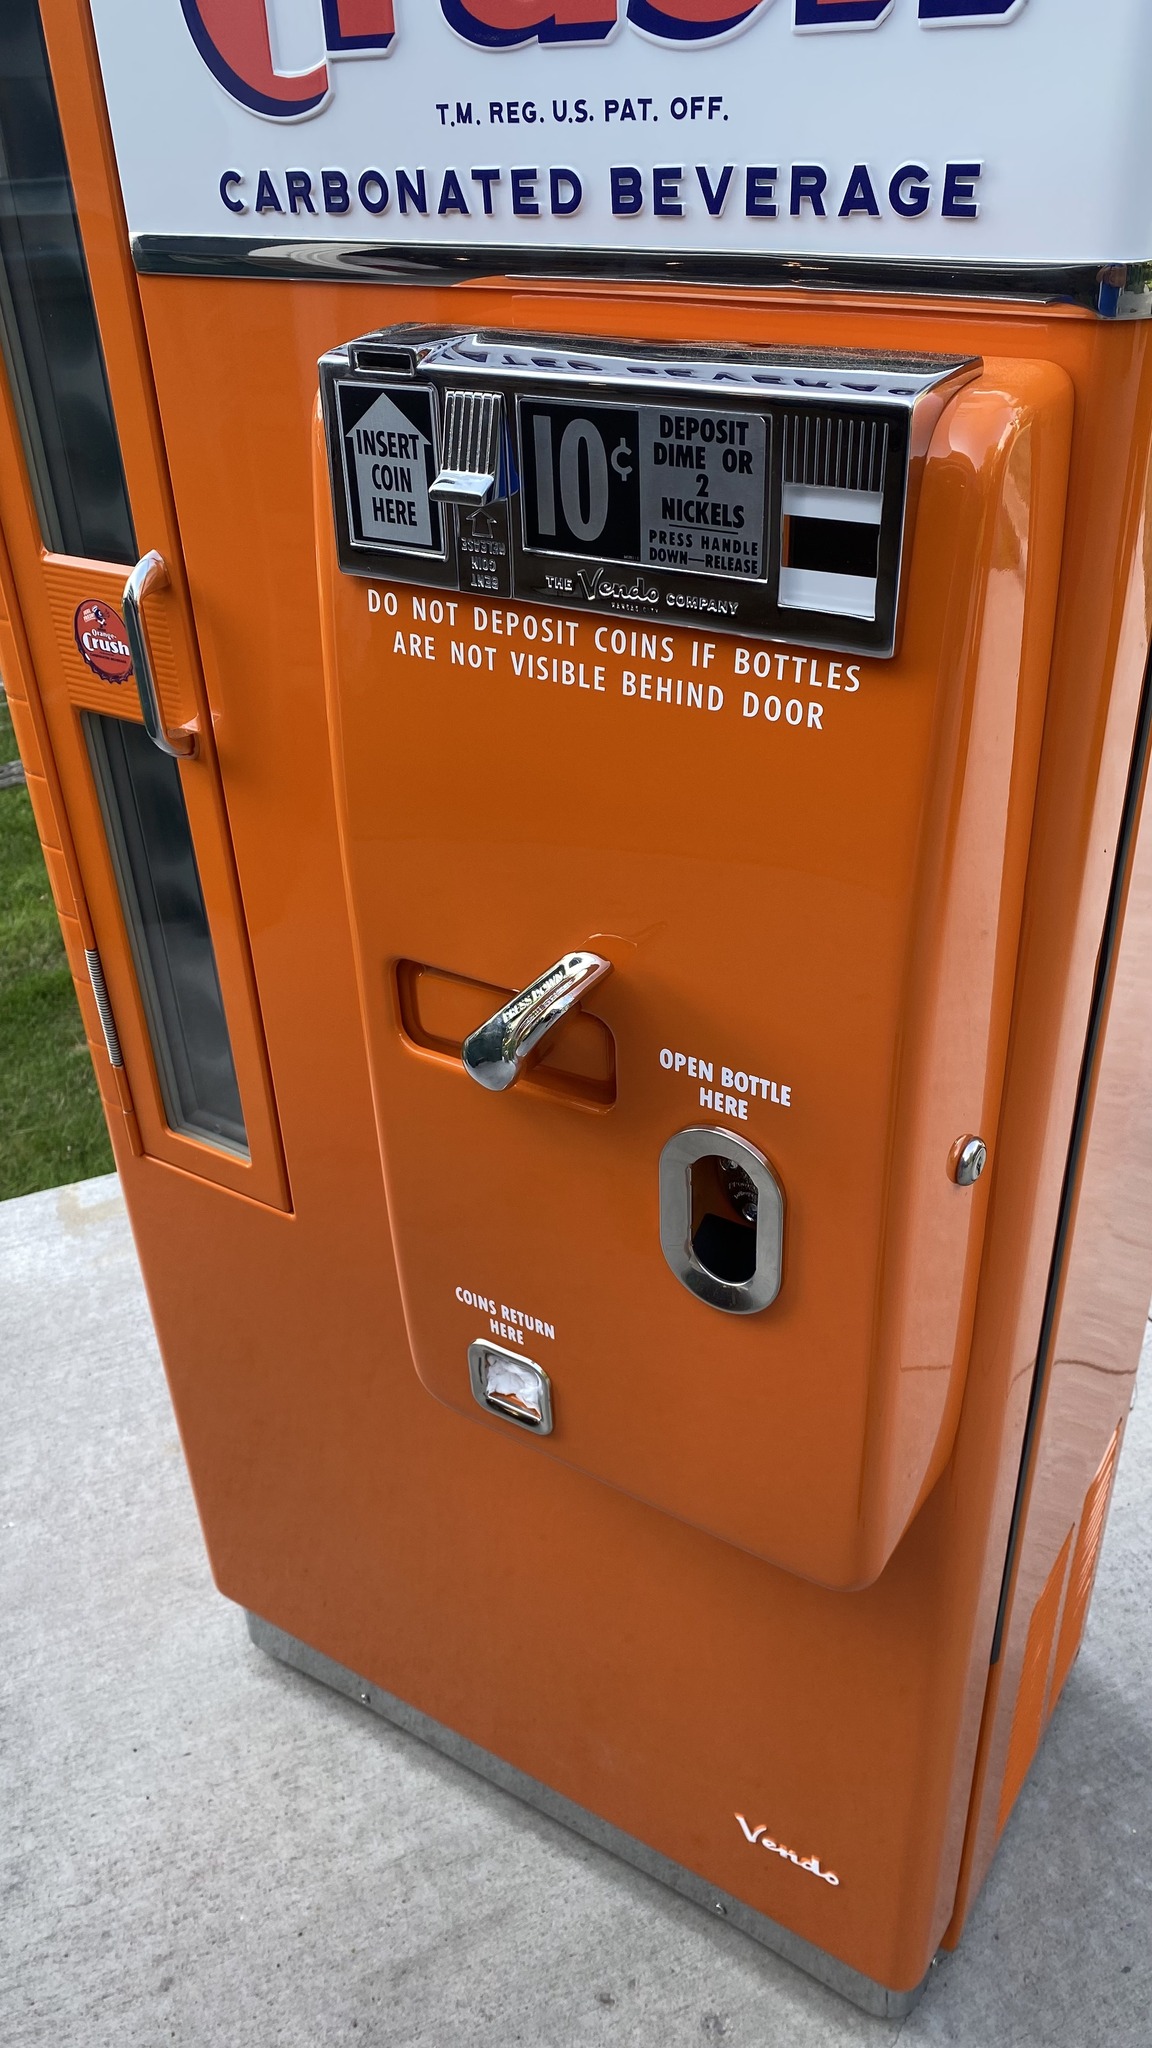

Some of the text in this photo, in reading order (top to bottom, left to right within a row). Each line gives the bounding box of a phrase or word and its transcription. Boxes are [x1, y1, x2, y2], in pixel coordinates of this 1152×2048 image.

[436, 96, 729, 127] T.M. REG. U.S. PAT. OFF.
[218, 161, 983, 218] CARBONATED BEVERAGE
[356, 429, 420, 461] INSERT
[659, 414, 749, 446] DEPOSIT
[653, 442, 753, 474] DIME OR
[371, 463, 412, 493] COIN
[695, 473, 709, 498] 2
[372, 497, 418, 526] HERE
[661, 497, 745, 529] NICKELS
[649, 529, 758, 556] PRESS HANDLE
[545, 567, 739, 615] THE Vendo COMPANY
[82, 632, 130, 656] Crush
[367, 588, 861, 693] DO NOT DEPOSIT COINS IF BOTTLES
[392, 631, 823, 730] ARE NOT VISIBLE BEHIND DOOR
[659, 1048, 792, 1107] OPEN BOTTLE
[699, 1087, 748, 1121] HERE
[455, 1286, 555, 1340] COINS RETURN
[489, 1318, 524, 1345] HERE
[734, 1812, 840, 1886] Vendo
